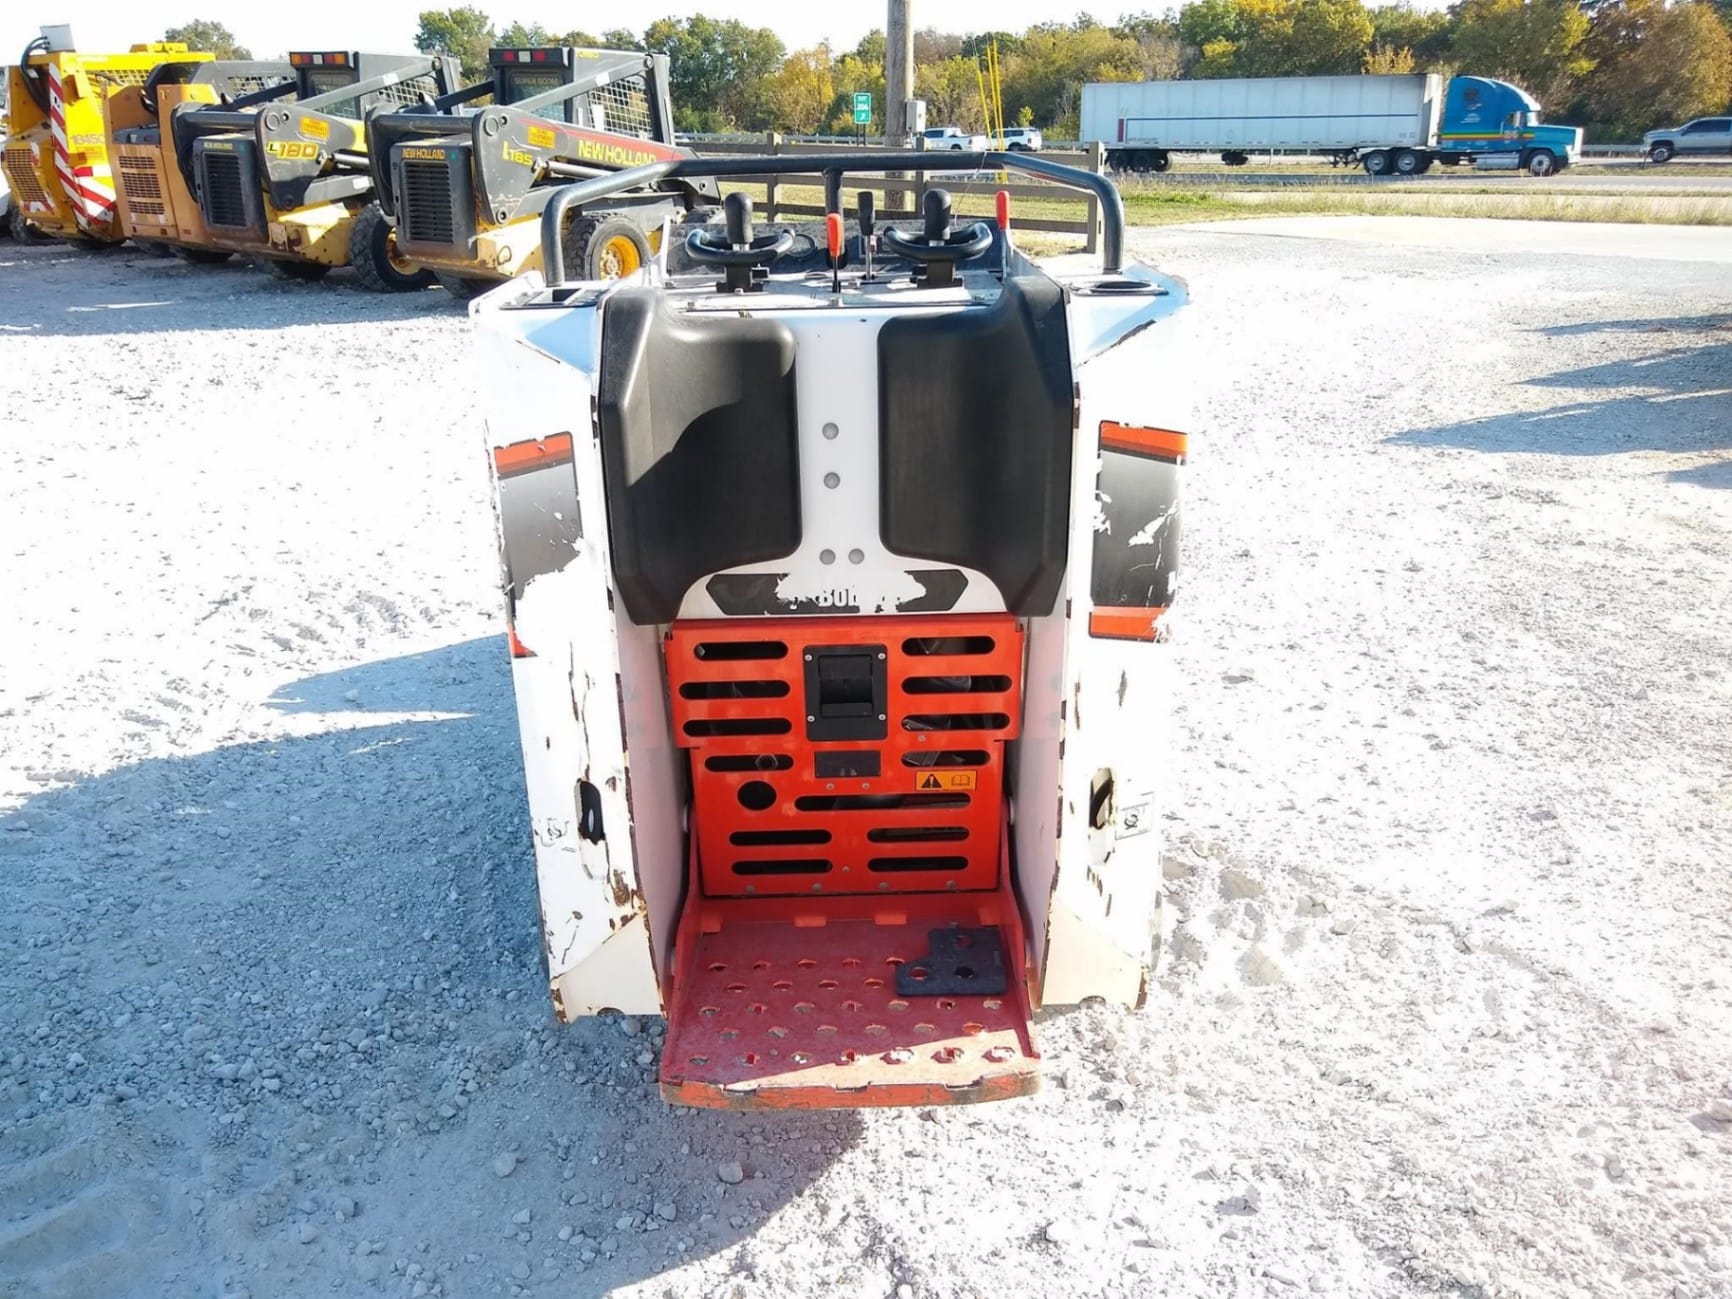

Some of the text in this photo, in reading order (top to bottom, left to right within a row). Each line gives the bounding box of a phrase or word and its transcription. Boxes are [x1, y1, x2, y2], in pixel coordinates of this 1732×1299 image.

[402, 147, 446, 160] NEW HOLLAND
[578, 140, 605, 161] NEW
